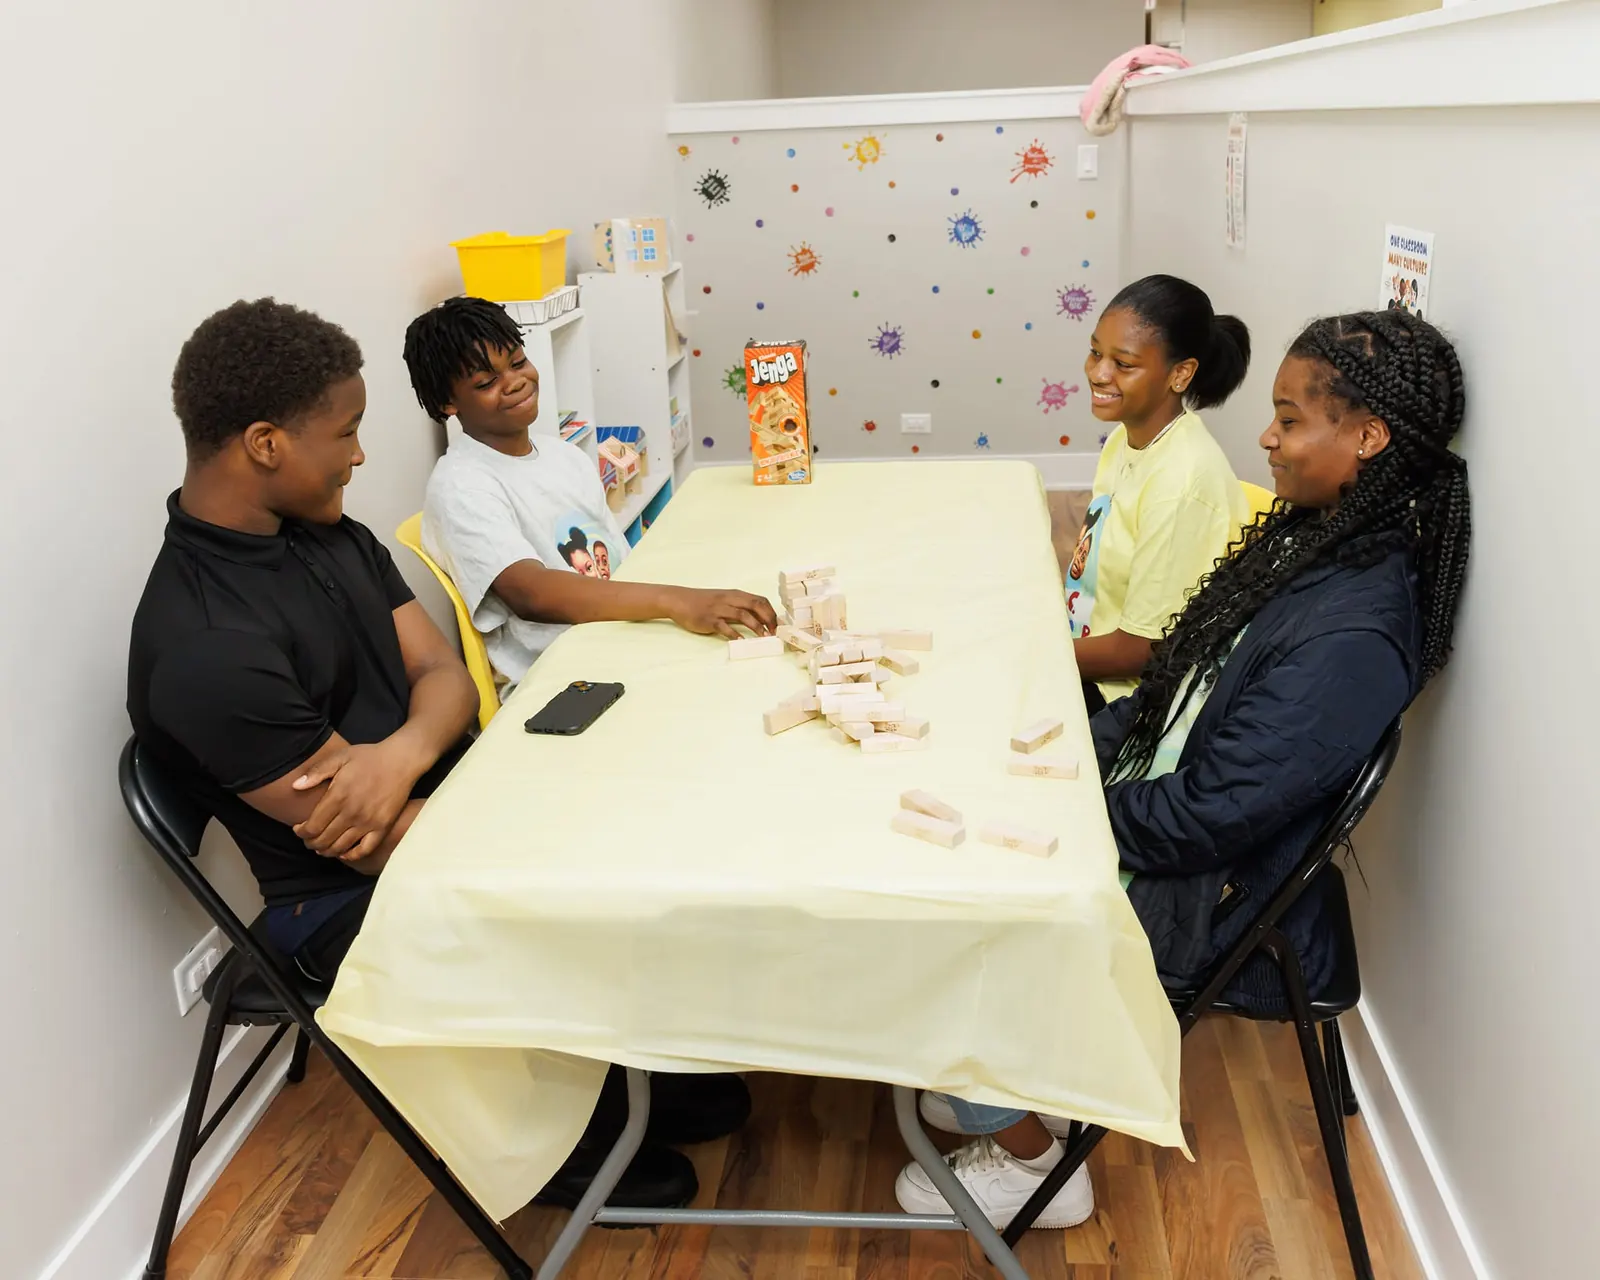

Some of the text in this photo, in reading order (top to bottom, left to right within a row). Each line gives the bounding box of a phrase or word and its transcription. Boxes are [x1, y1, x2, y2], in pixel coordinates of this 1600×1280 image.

[1390, 235, 1399, 247] ONE
[1388, 252, 1401, 267] MANY
[750, 351, 798, 384] Jenga
